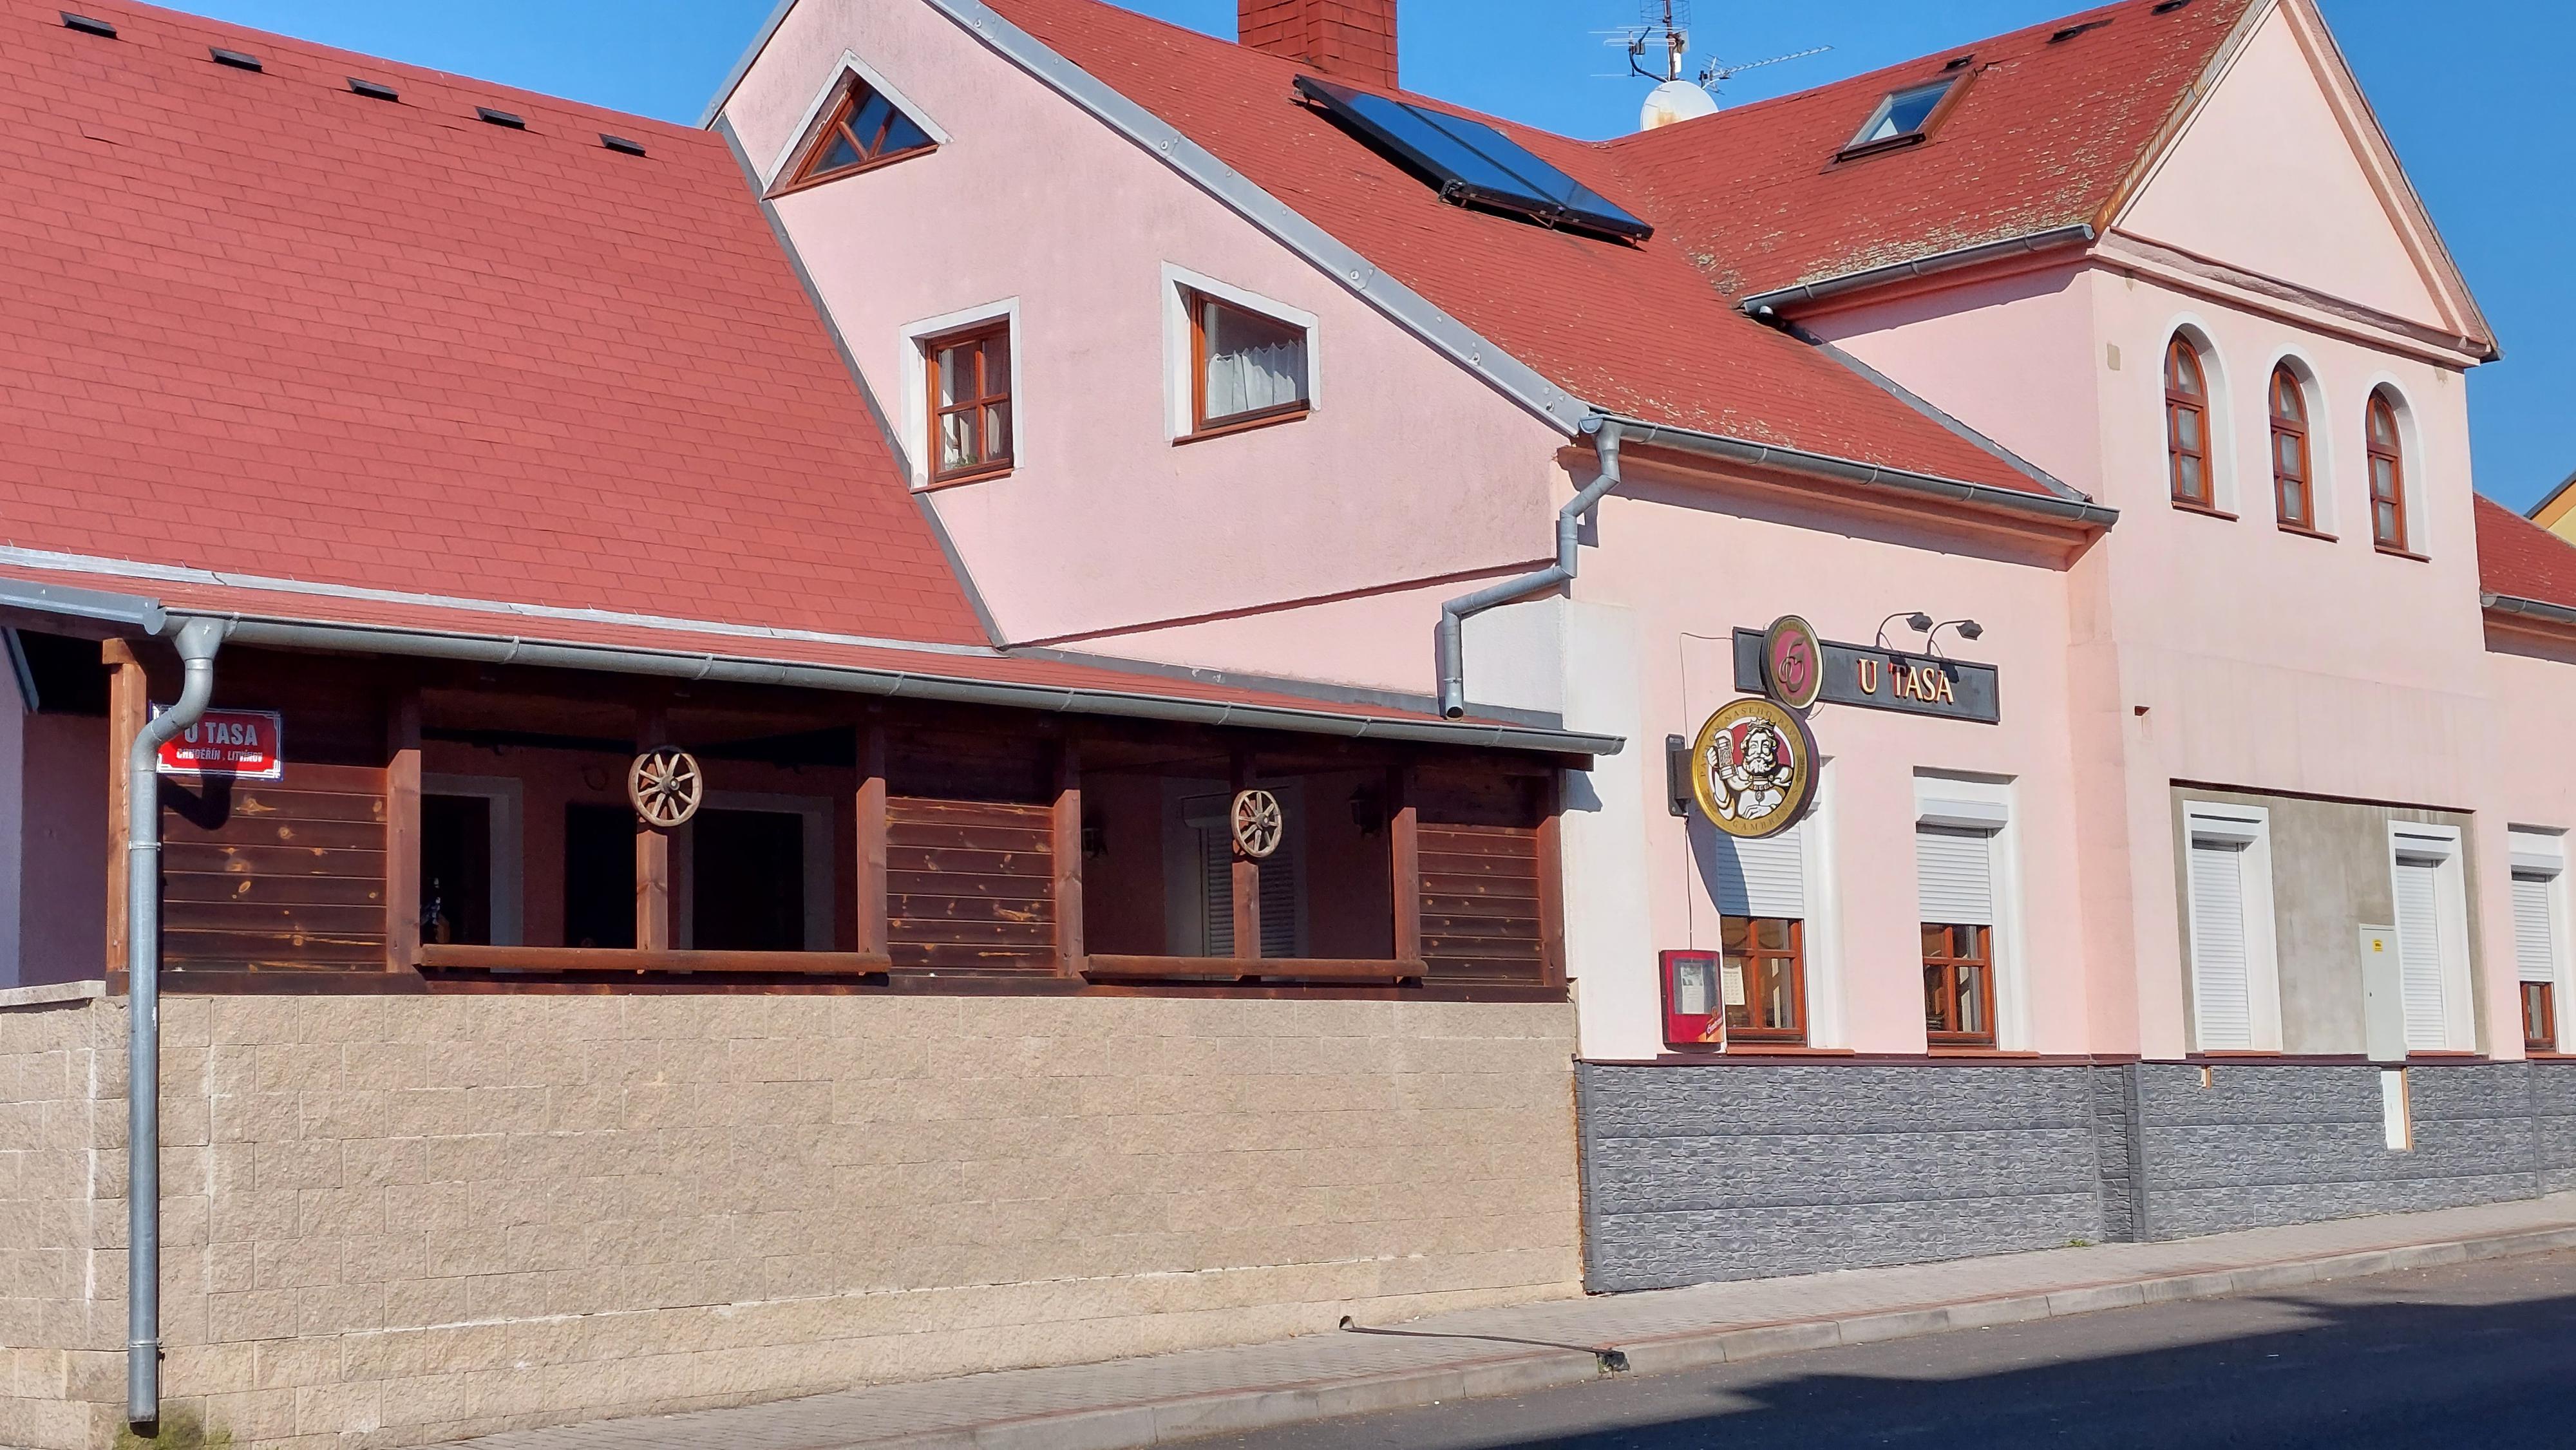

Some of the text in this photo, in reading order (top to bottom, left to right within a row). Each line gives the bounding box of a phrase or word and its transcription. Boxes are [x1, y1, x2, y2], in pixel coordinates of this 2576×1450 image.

[1857, 658, 1955, 705] U TASA
[185, 722, 258, 746] U TASA
[1732, 789, 1799, 831] GAMBRINUS
